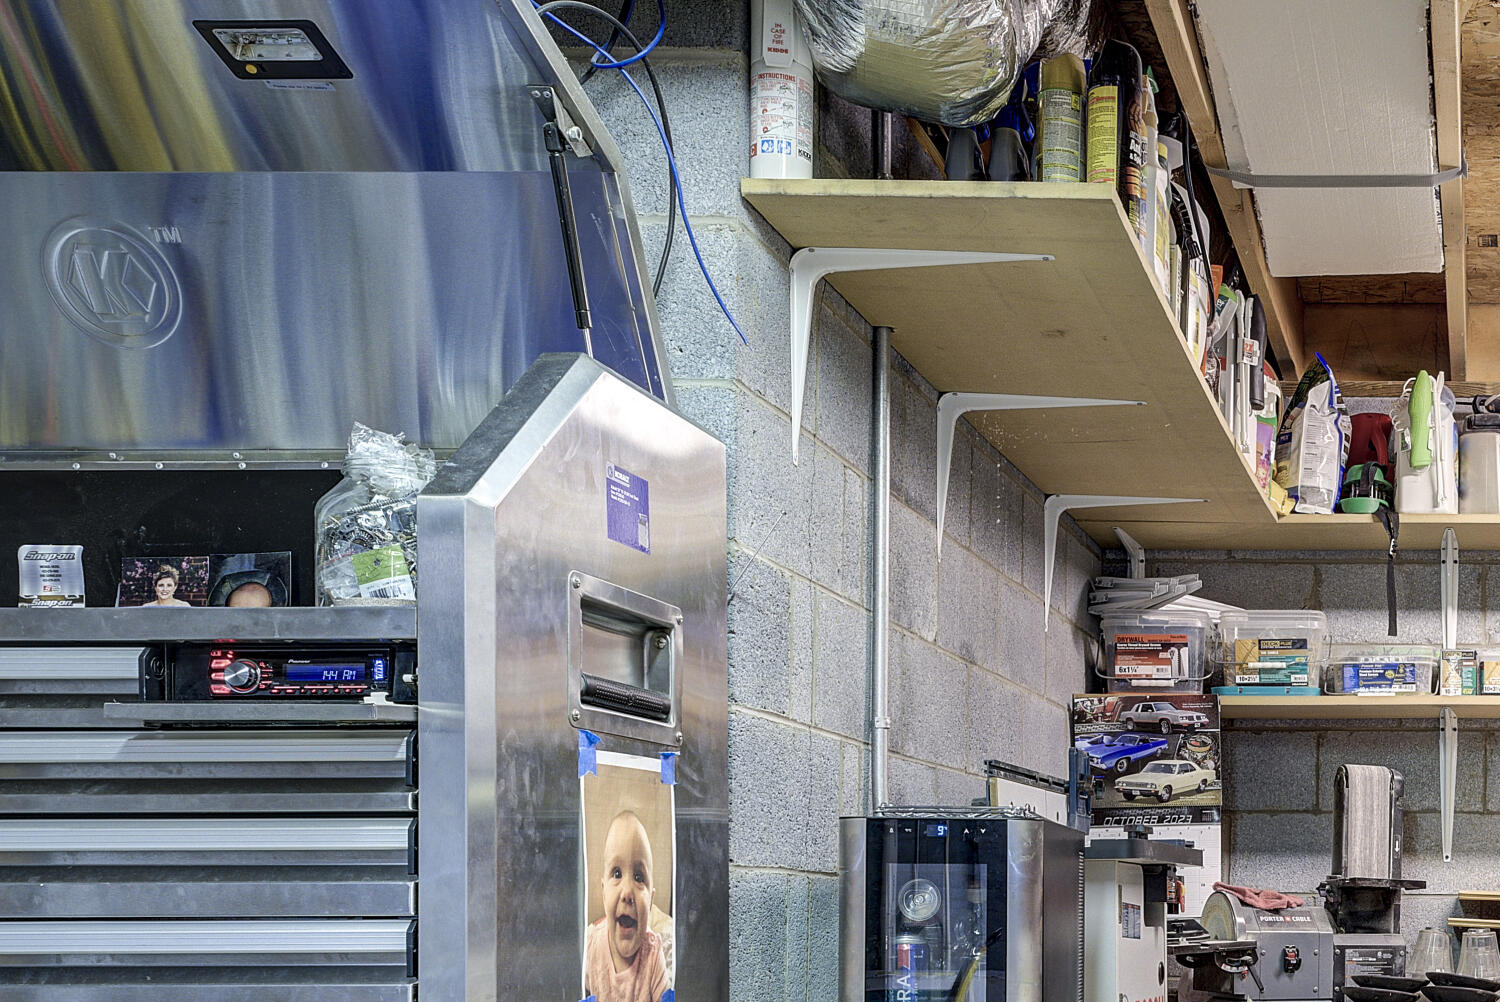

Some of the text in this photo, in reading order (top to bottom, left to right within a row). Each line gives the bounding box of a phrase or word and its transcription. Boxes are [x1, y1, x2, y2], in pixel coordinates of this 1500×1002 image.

[758, 72, 795, 82] INSTRUCTIONS
[24, 551, 75, 562] Snap-on
[32, 599, 73, 609] Snap-on
[1104, 815, 1192, 826] OCTOBER 2023
